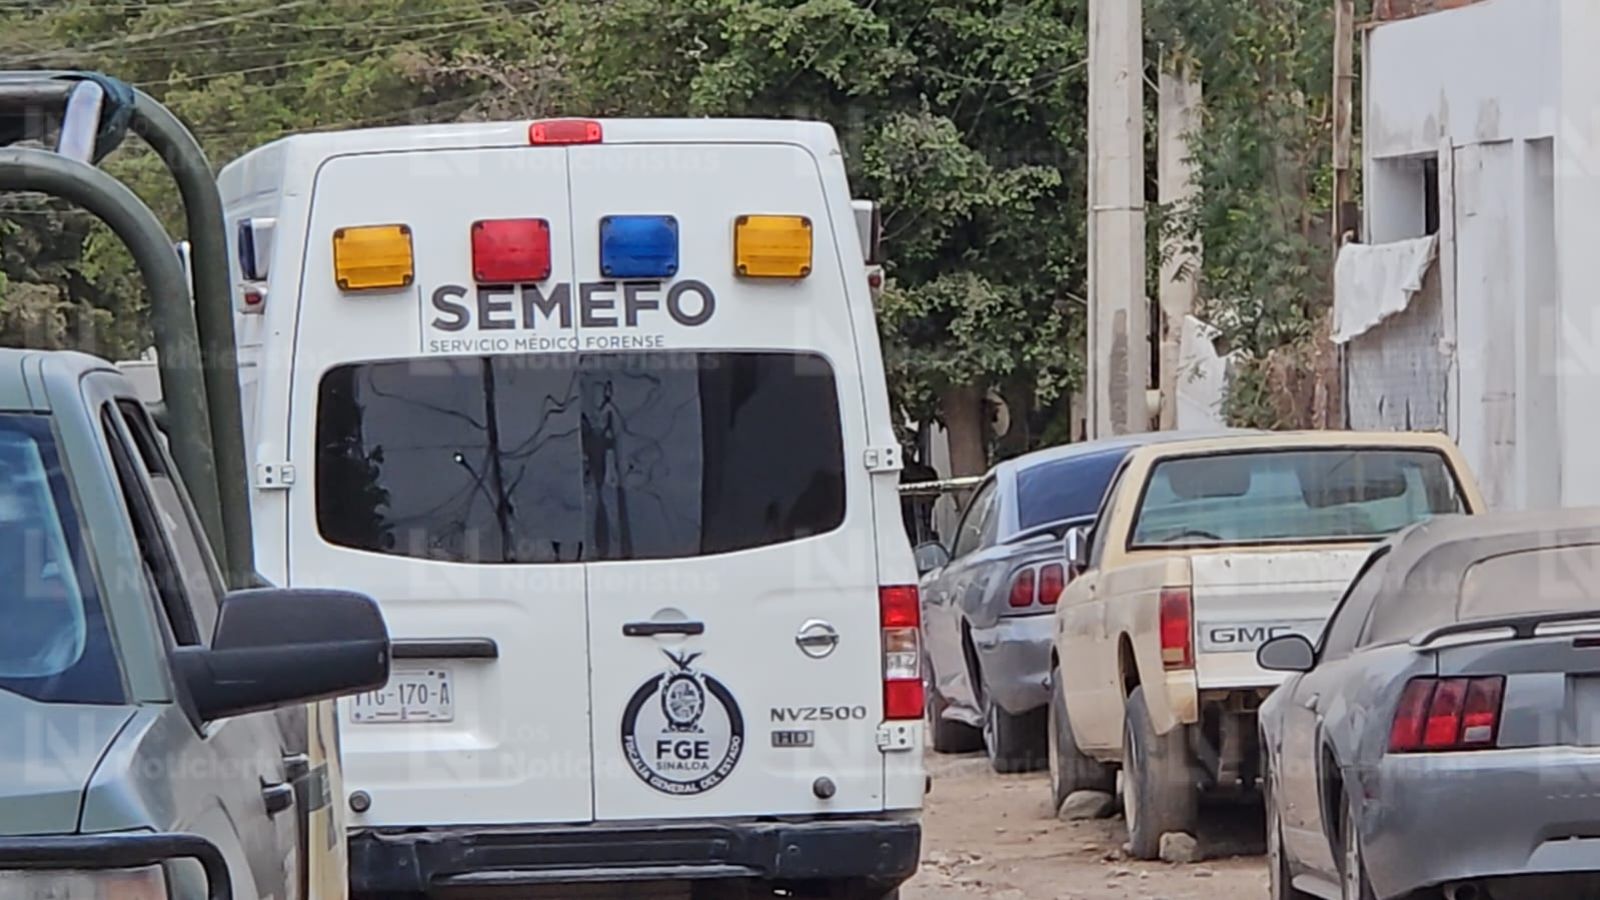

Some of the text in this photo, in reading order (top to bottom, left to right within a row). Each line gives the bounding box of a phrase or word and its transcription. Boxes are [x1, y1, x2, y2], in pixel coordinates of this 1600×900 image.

[431, 279, 716, 331] SEMEFO
[430, 334, 664, 352] SERVICIO MÉDICO FORENSE
[776, 731, 809, 745] HD
[656, 740, 710, 760] FGE
[656, 761, 710, 771] SINALOA
[700, 772, 722, 791] DEL
[717, 734, 742, 776] ESTADO
